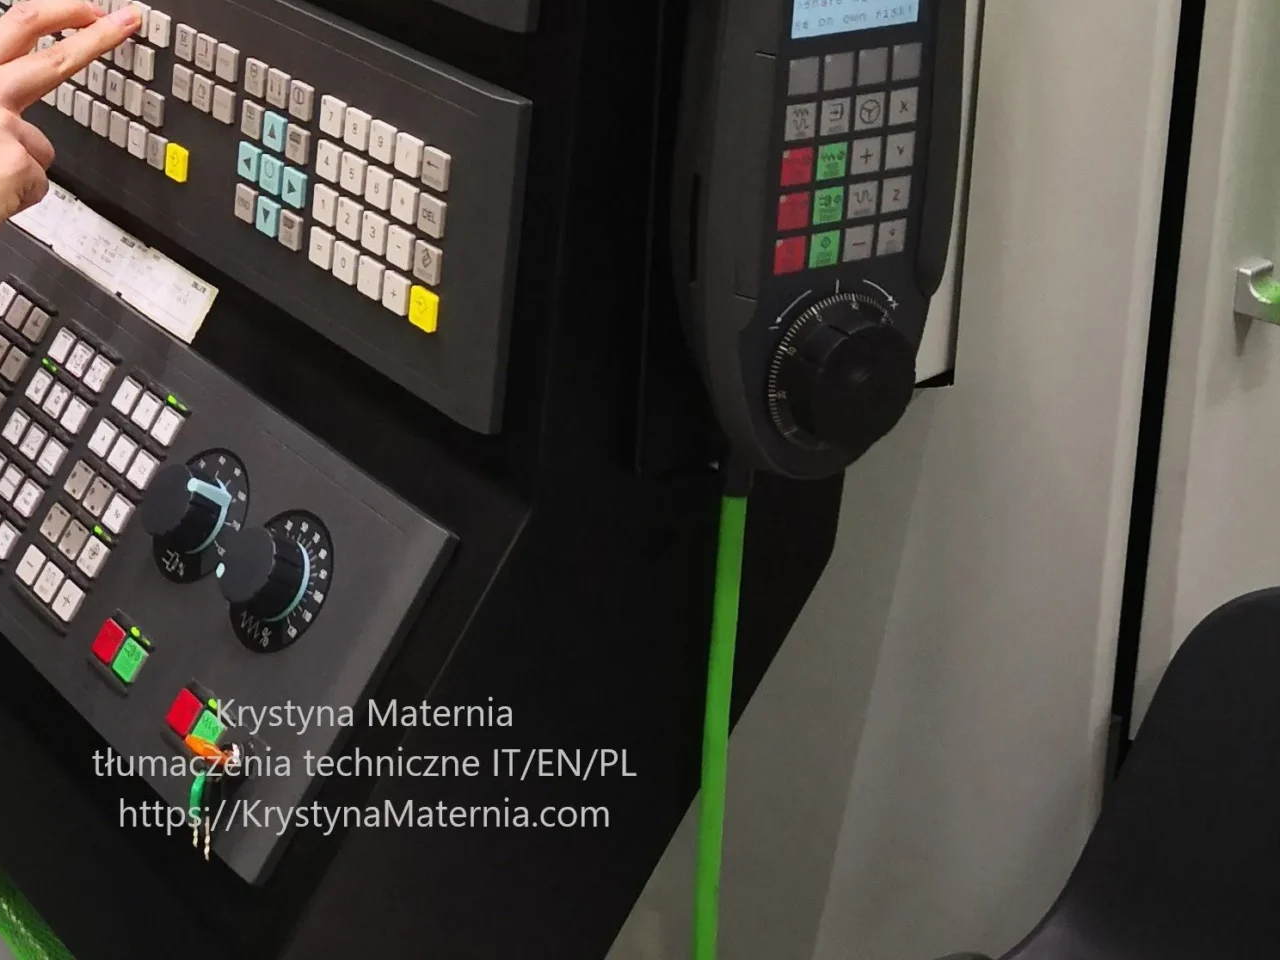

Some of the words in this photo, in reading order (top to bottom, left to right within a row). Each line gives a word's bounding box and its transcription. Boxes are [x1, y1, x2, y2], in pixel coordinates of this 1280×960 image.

[818, 15, 834, 28] on
[842, 12, 867, 25] own
[875, 4, 913, 21] risk!
[899, 99, 909, 114] X
[891, 188, 901, 202] Z
[421, 206, 437, 225] DEL
